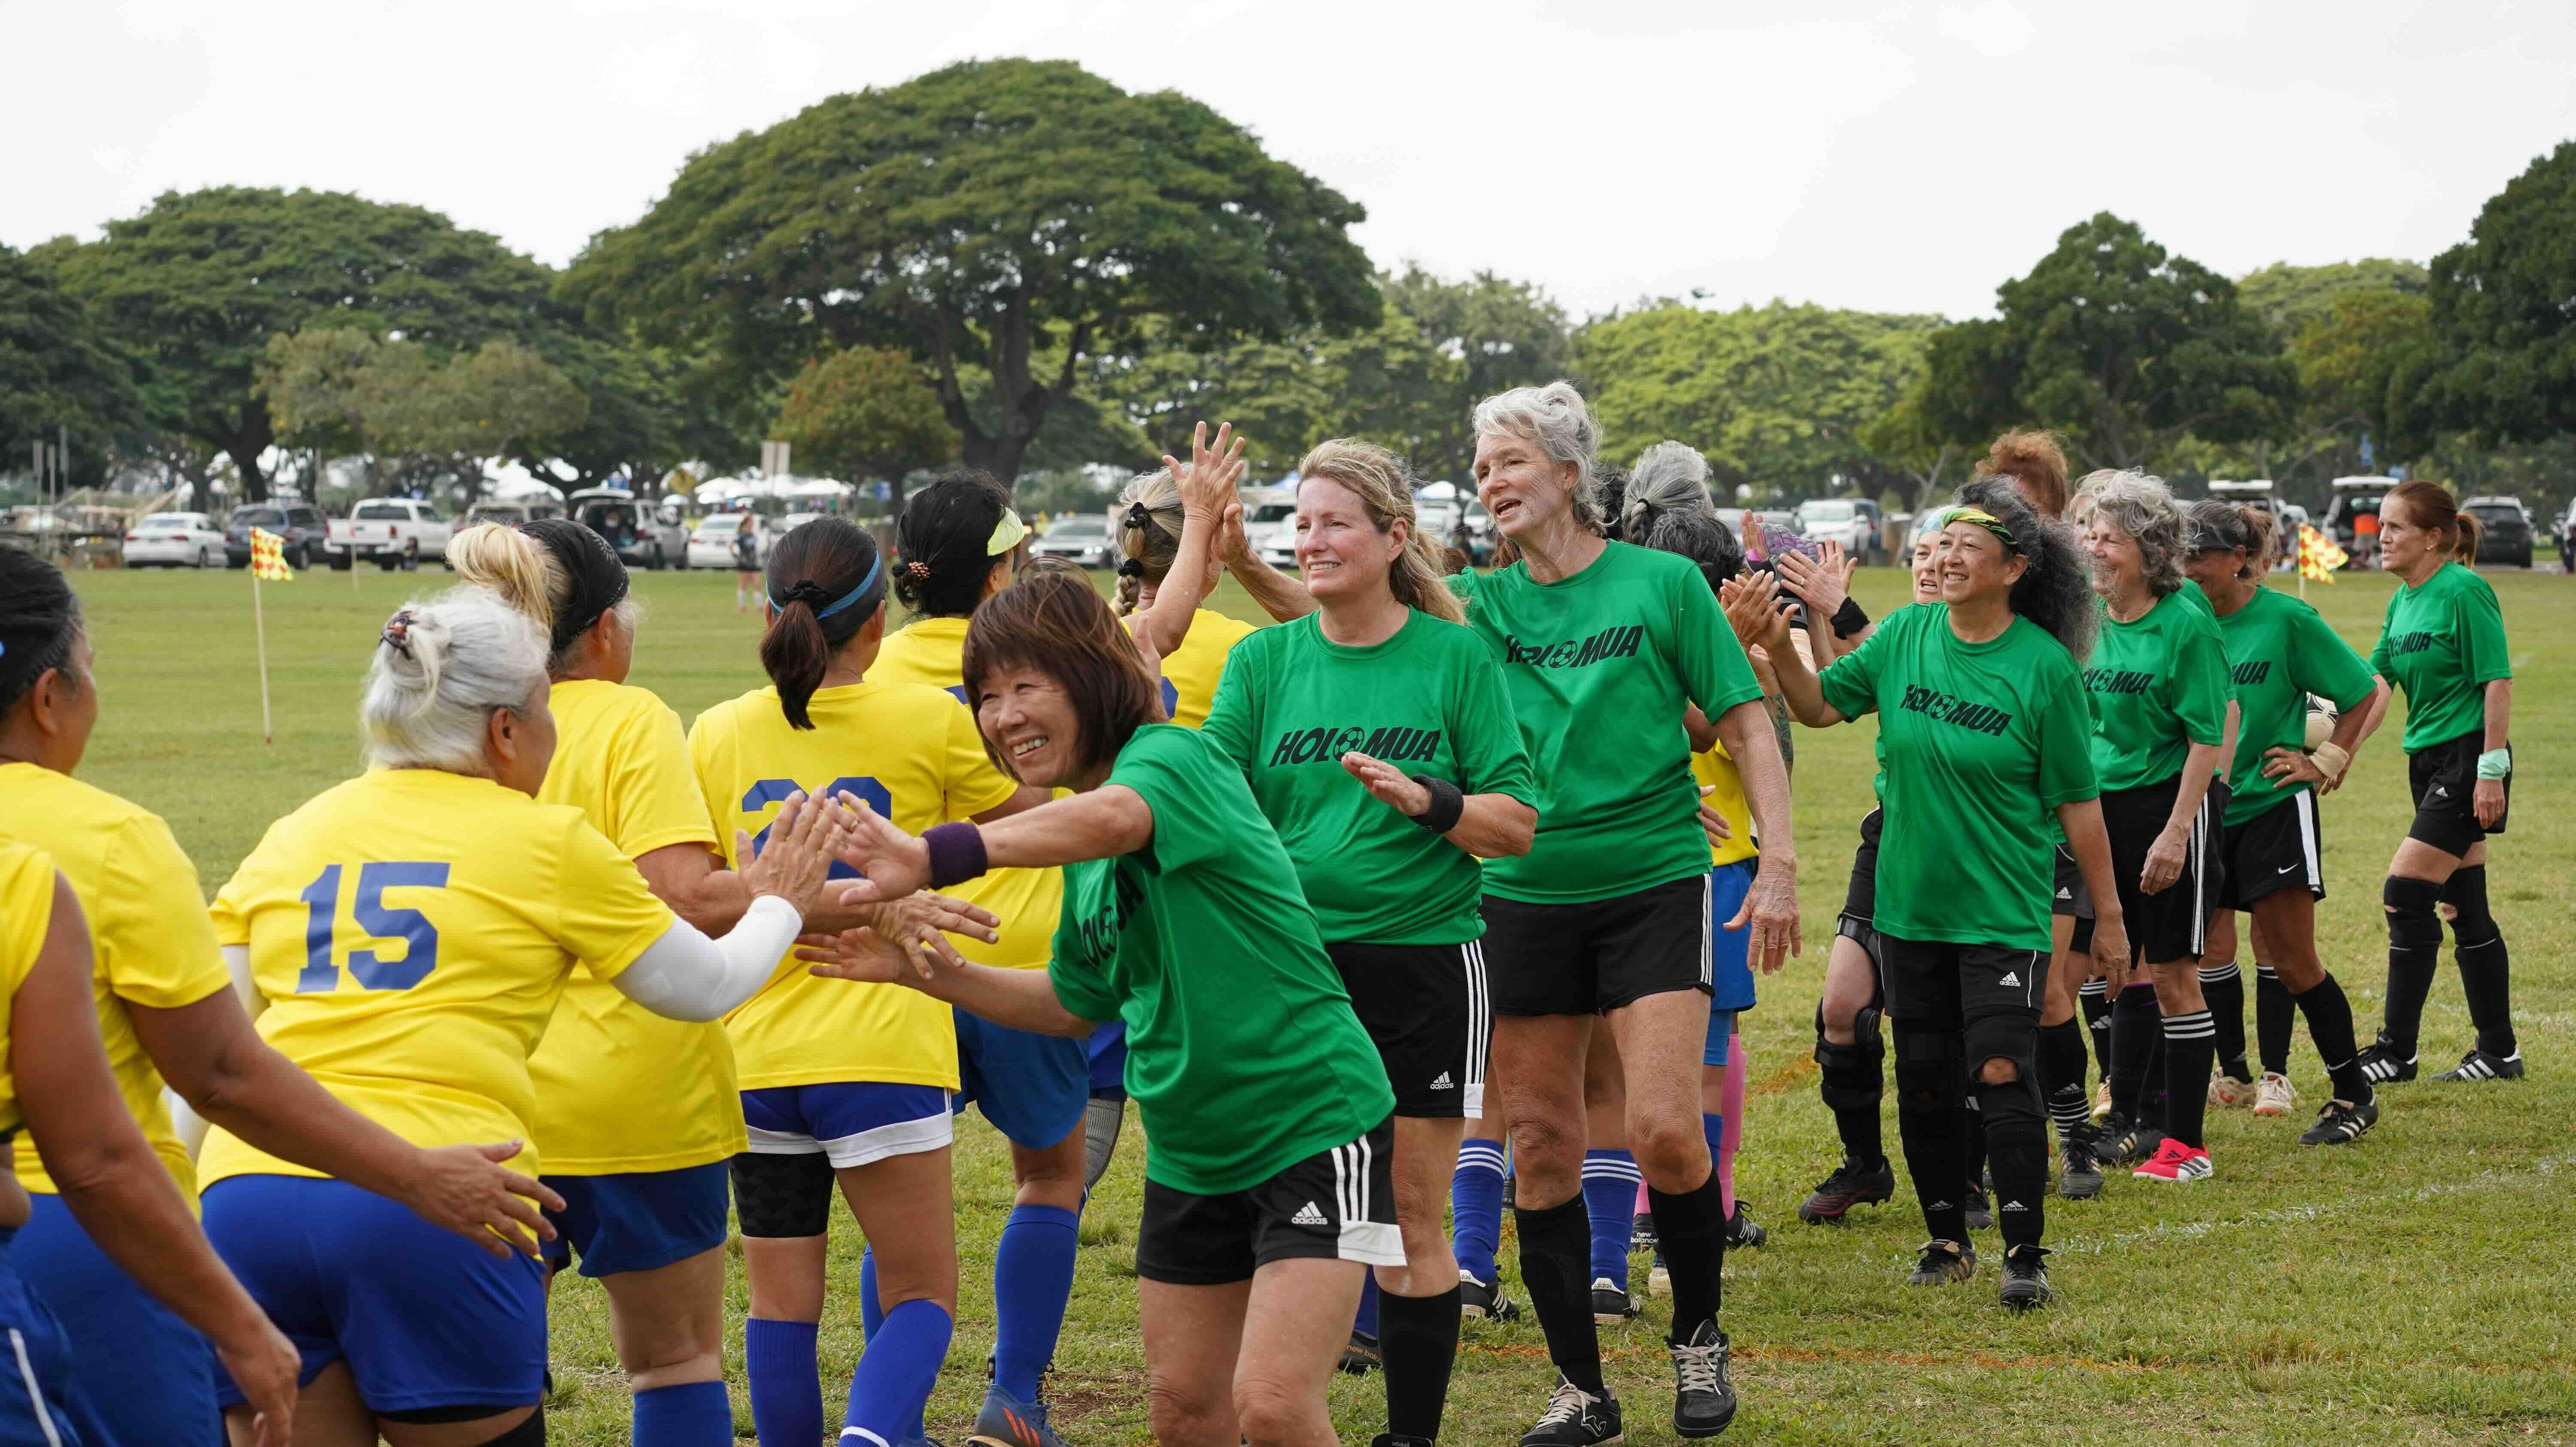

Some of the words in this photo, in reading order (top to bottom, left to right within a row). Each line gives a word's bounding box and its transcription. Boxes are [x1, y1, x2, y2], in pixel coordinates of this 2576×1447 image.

[1269, 727, 1441, 768] HOLOMUA
[295, 862, 450, 993] 15
[1291, 1216, 1328, 1225] adidas
